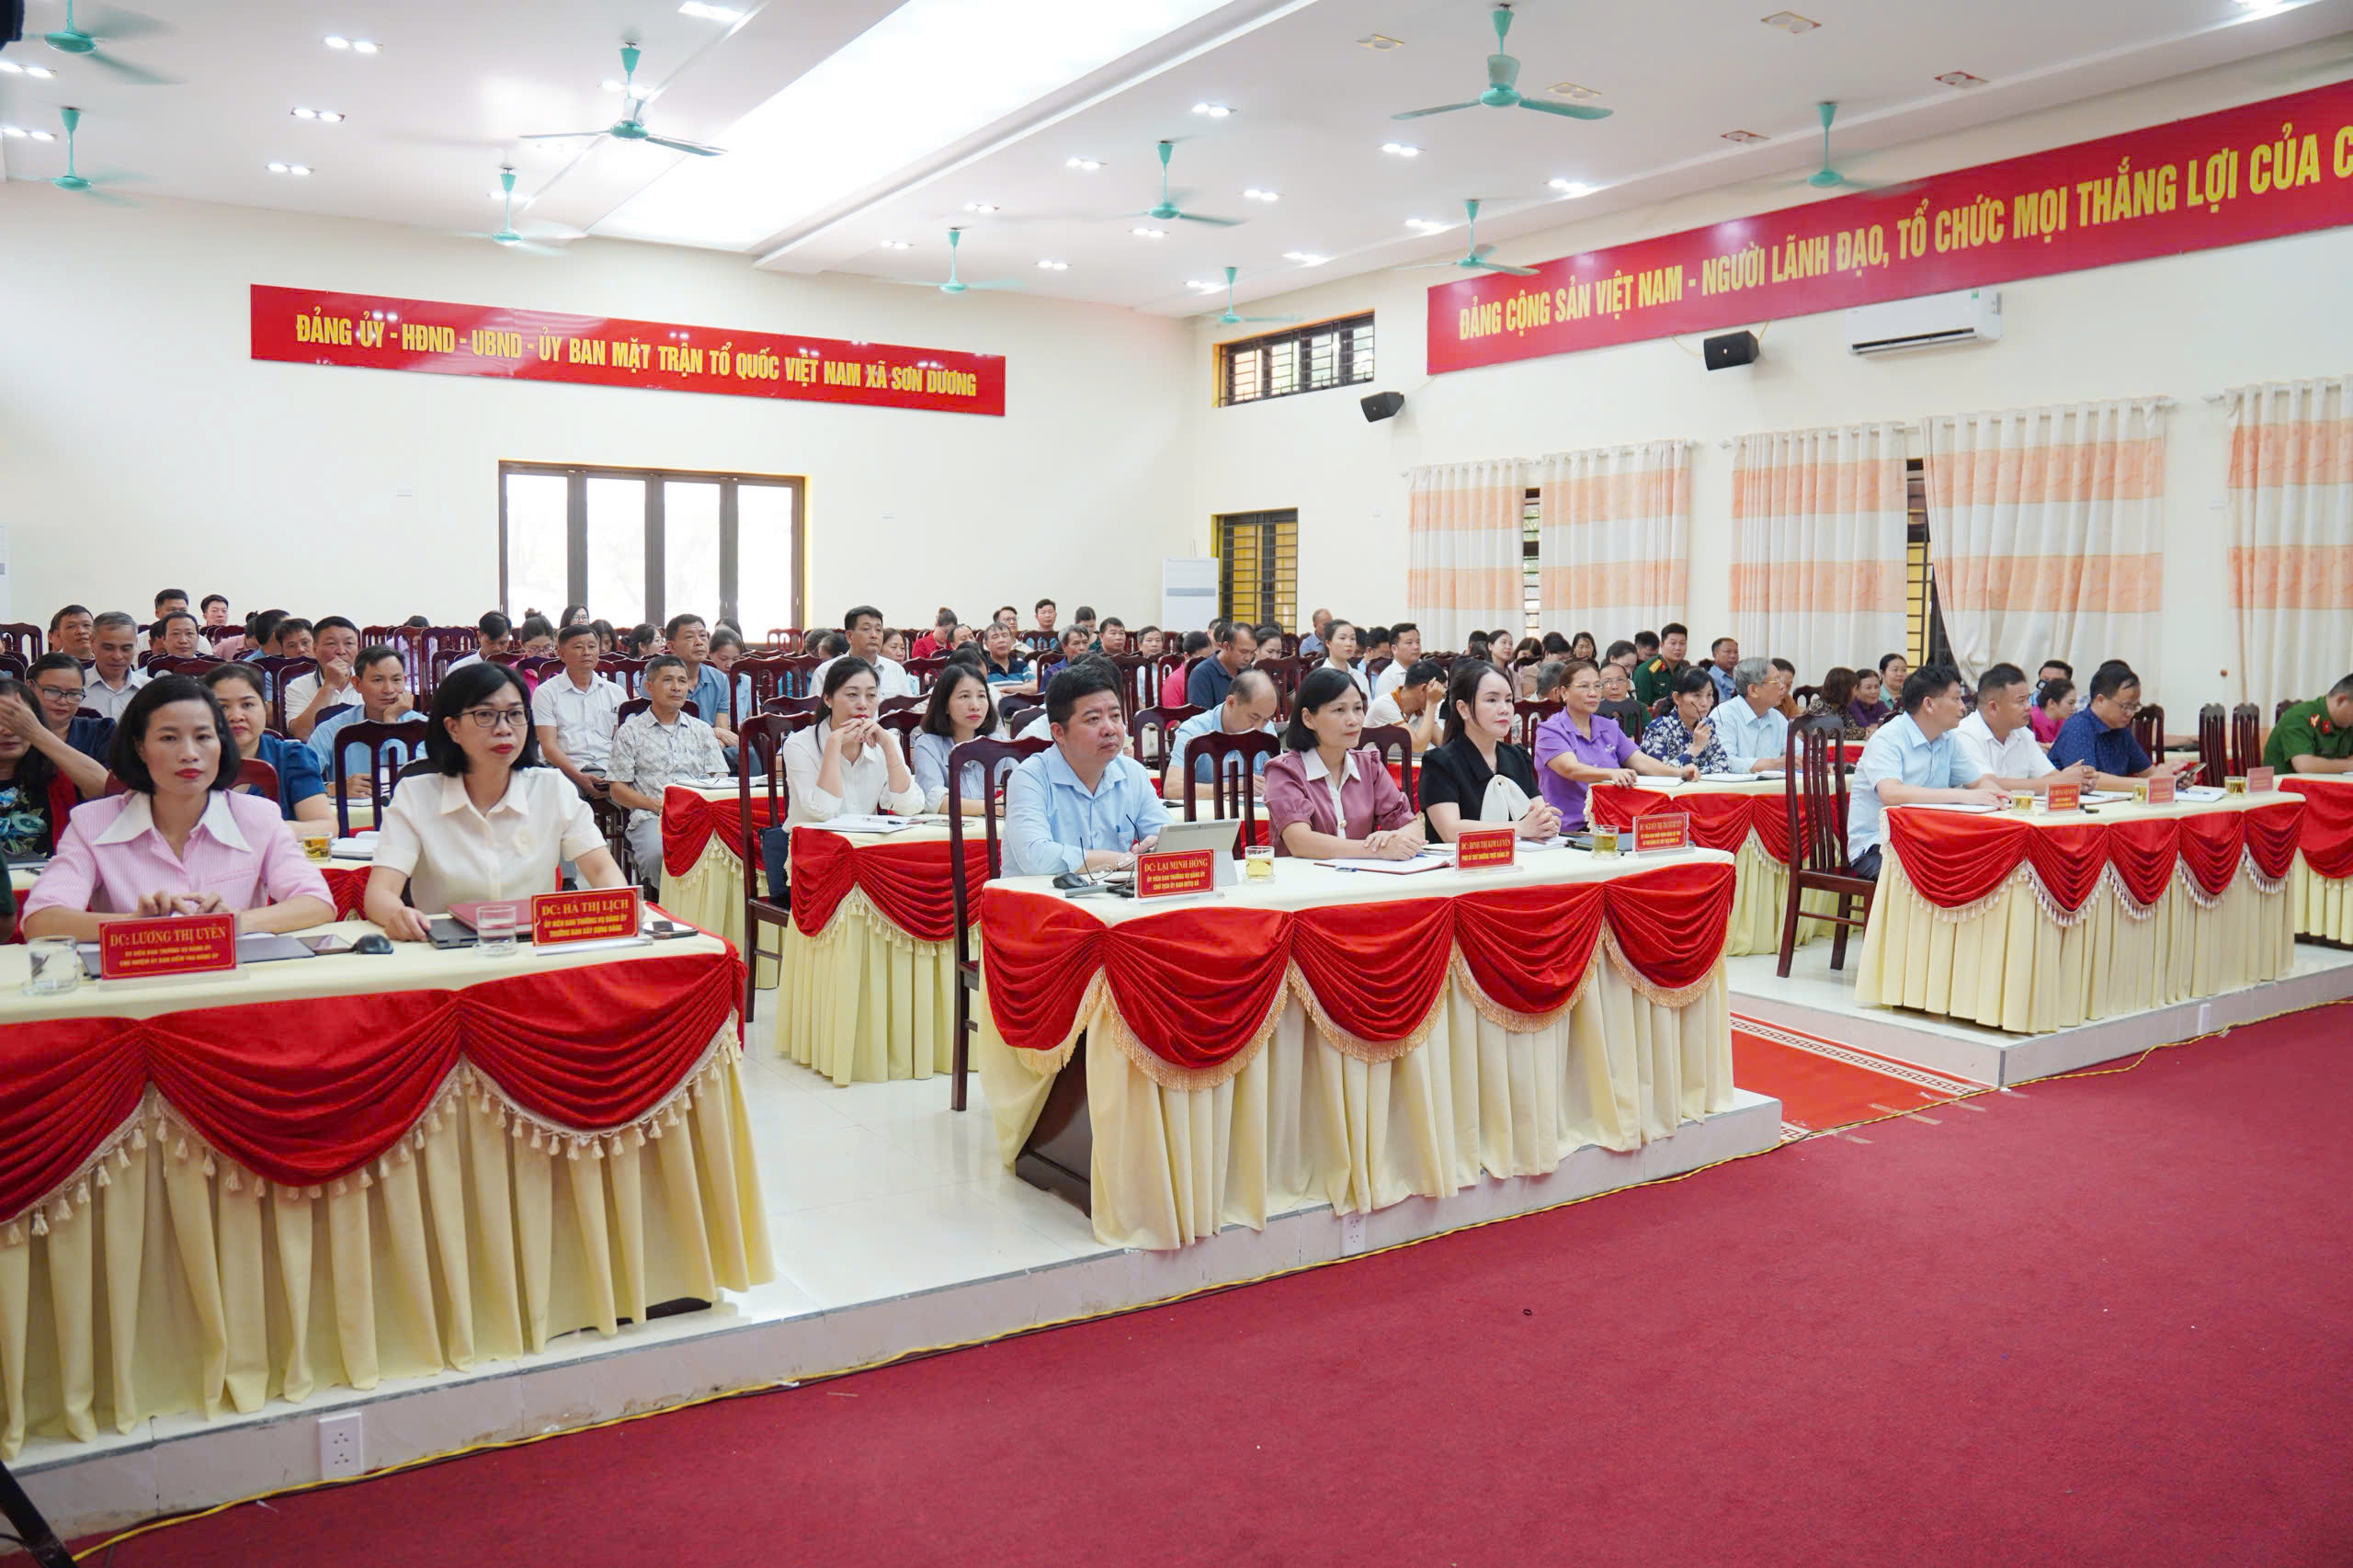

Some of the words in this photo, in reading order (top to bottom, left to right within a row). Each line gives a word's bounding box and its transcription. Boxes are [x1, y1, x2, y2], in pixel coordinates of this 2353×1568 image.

[1459, 290, 1501, 340] ĐẢNG
[1506, 290, 1551, 336] CỘNG
[1555, 275, 1591, 323] SẢN
[1596, 269, 1634, 320] VIỆT
[1638, 265, 1683, 306] NAM
[1701, 242, 1766, 296] NGƯỜI
[1771, 234, 1830, 282] LÃNH
[1836, 224, 1889, 277] ĐẠO,
[1897, 199, 1929, 261] TỔ
[1935, 196, 2005, 254] CHỨC
[2013, 187, 2067, 244] MỌI
[2076, 156, 2177, 228] THẮNG
[2187, 148, 2239, 214] LỢI
[2249, 122, 2321, 195] CỦA
[296, 306, 352, 347] ĐẢNG
[360, 311, 385, 348] ỦY
[402, 324, 455, 354] HĐND
[472, 329, 522, 359] UBND
[539, 326, 563, 362] ỦY
[569, 337, 606, 366] BAN
[612, 336, 650, 373] MẶT
[658, 341, 703, 378] TRẬN
[710, 341, 732, 376] TỔ
[736, 347, 779, 381] QUỐC
[785, 354, 819, 387] VIỆT
[824, 359, 860, 387] NAM
[866, 359, 888, 389] XÃ
[891, 366, 923, 392] SƠN
[926, 369, 977, 397] DƯƠNG
[1170, 860, 1188, 869] MINH
[580, 901, 600, 914] THỊ
[603, 899, 629, 912] LỊCH
[174, 927, 193, 943] THỊ
